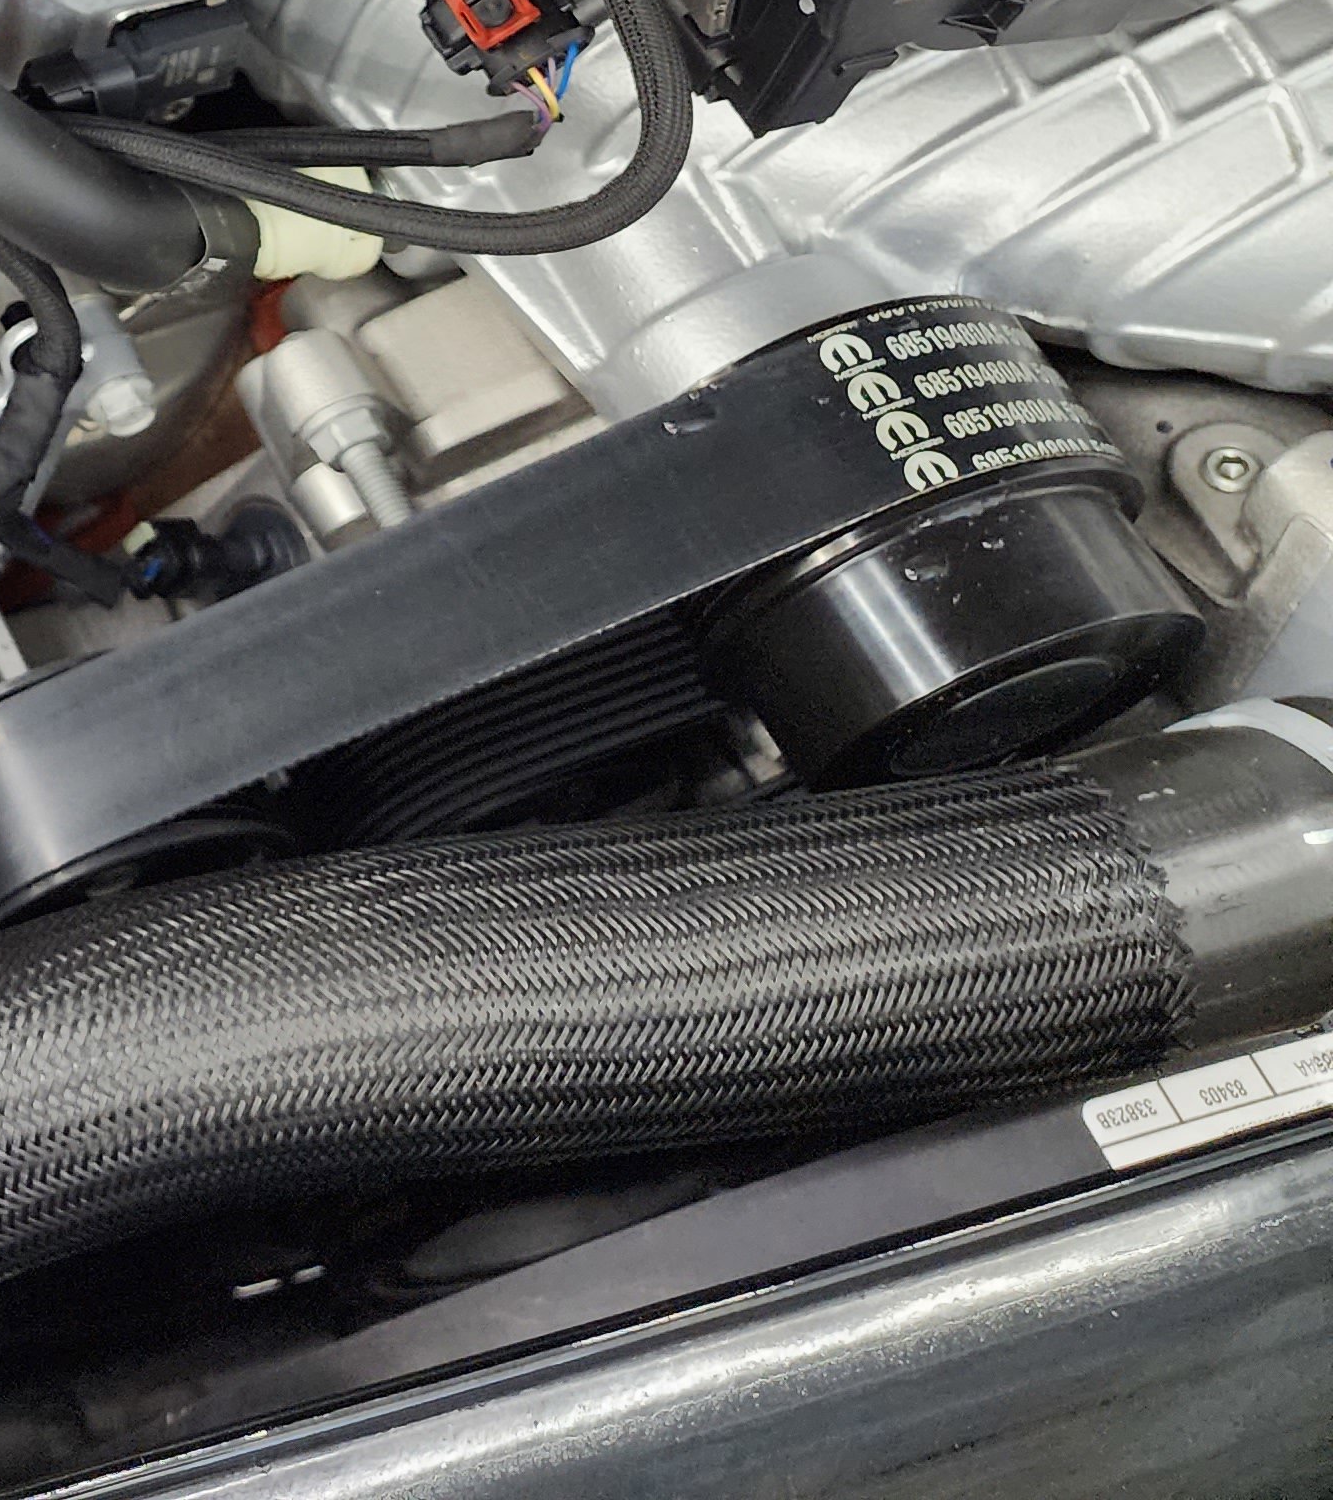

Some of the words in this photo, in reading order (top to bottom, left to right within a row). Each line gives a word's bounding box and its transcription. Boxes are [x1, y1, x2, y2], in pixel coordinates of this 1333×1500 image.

[884, 321, 1006, 361] 68519480AA
[913, 359, 1039, 399] 68519480AA
[942, 398, 1069, 439] 68519480AA
[1198, 1078, 1249, 1107] 83403
[1095, 1097, 1159, 1130] 33823B
